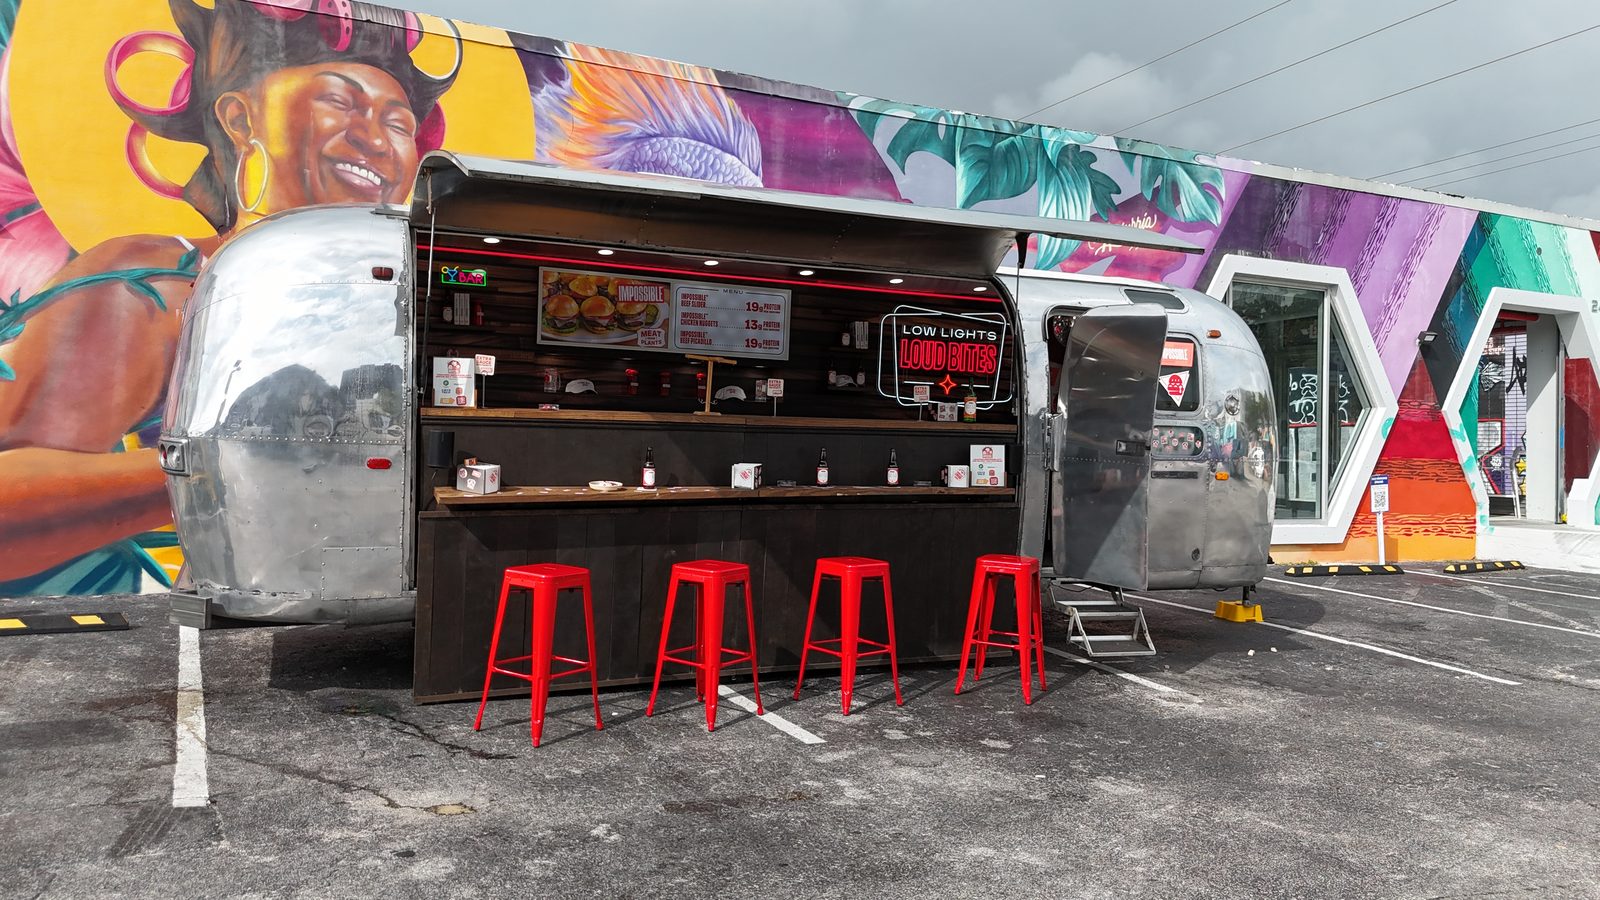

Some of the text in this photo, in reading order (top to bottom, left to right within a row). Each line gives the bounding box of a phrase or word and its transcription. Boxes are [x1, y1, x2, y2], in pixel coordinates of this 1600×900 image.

[458, 271, 483, 284] BAR
[618, 285, 664, 302] IMPOSSIBLE
[764, 303, 780, 311] PROTEIN
[641, 330, 661, 338] MEAT
[903, 325, 997, 341] LOW LIGHTS
[763, 339, 779, 347] PROTEIN
[900, 338, 998, 374] LOUD BITES
